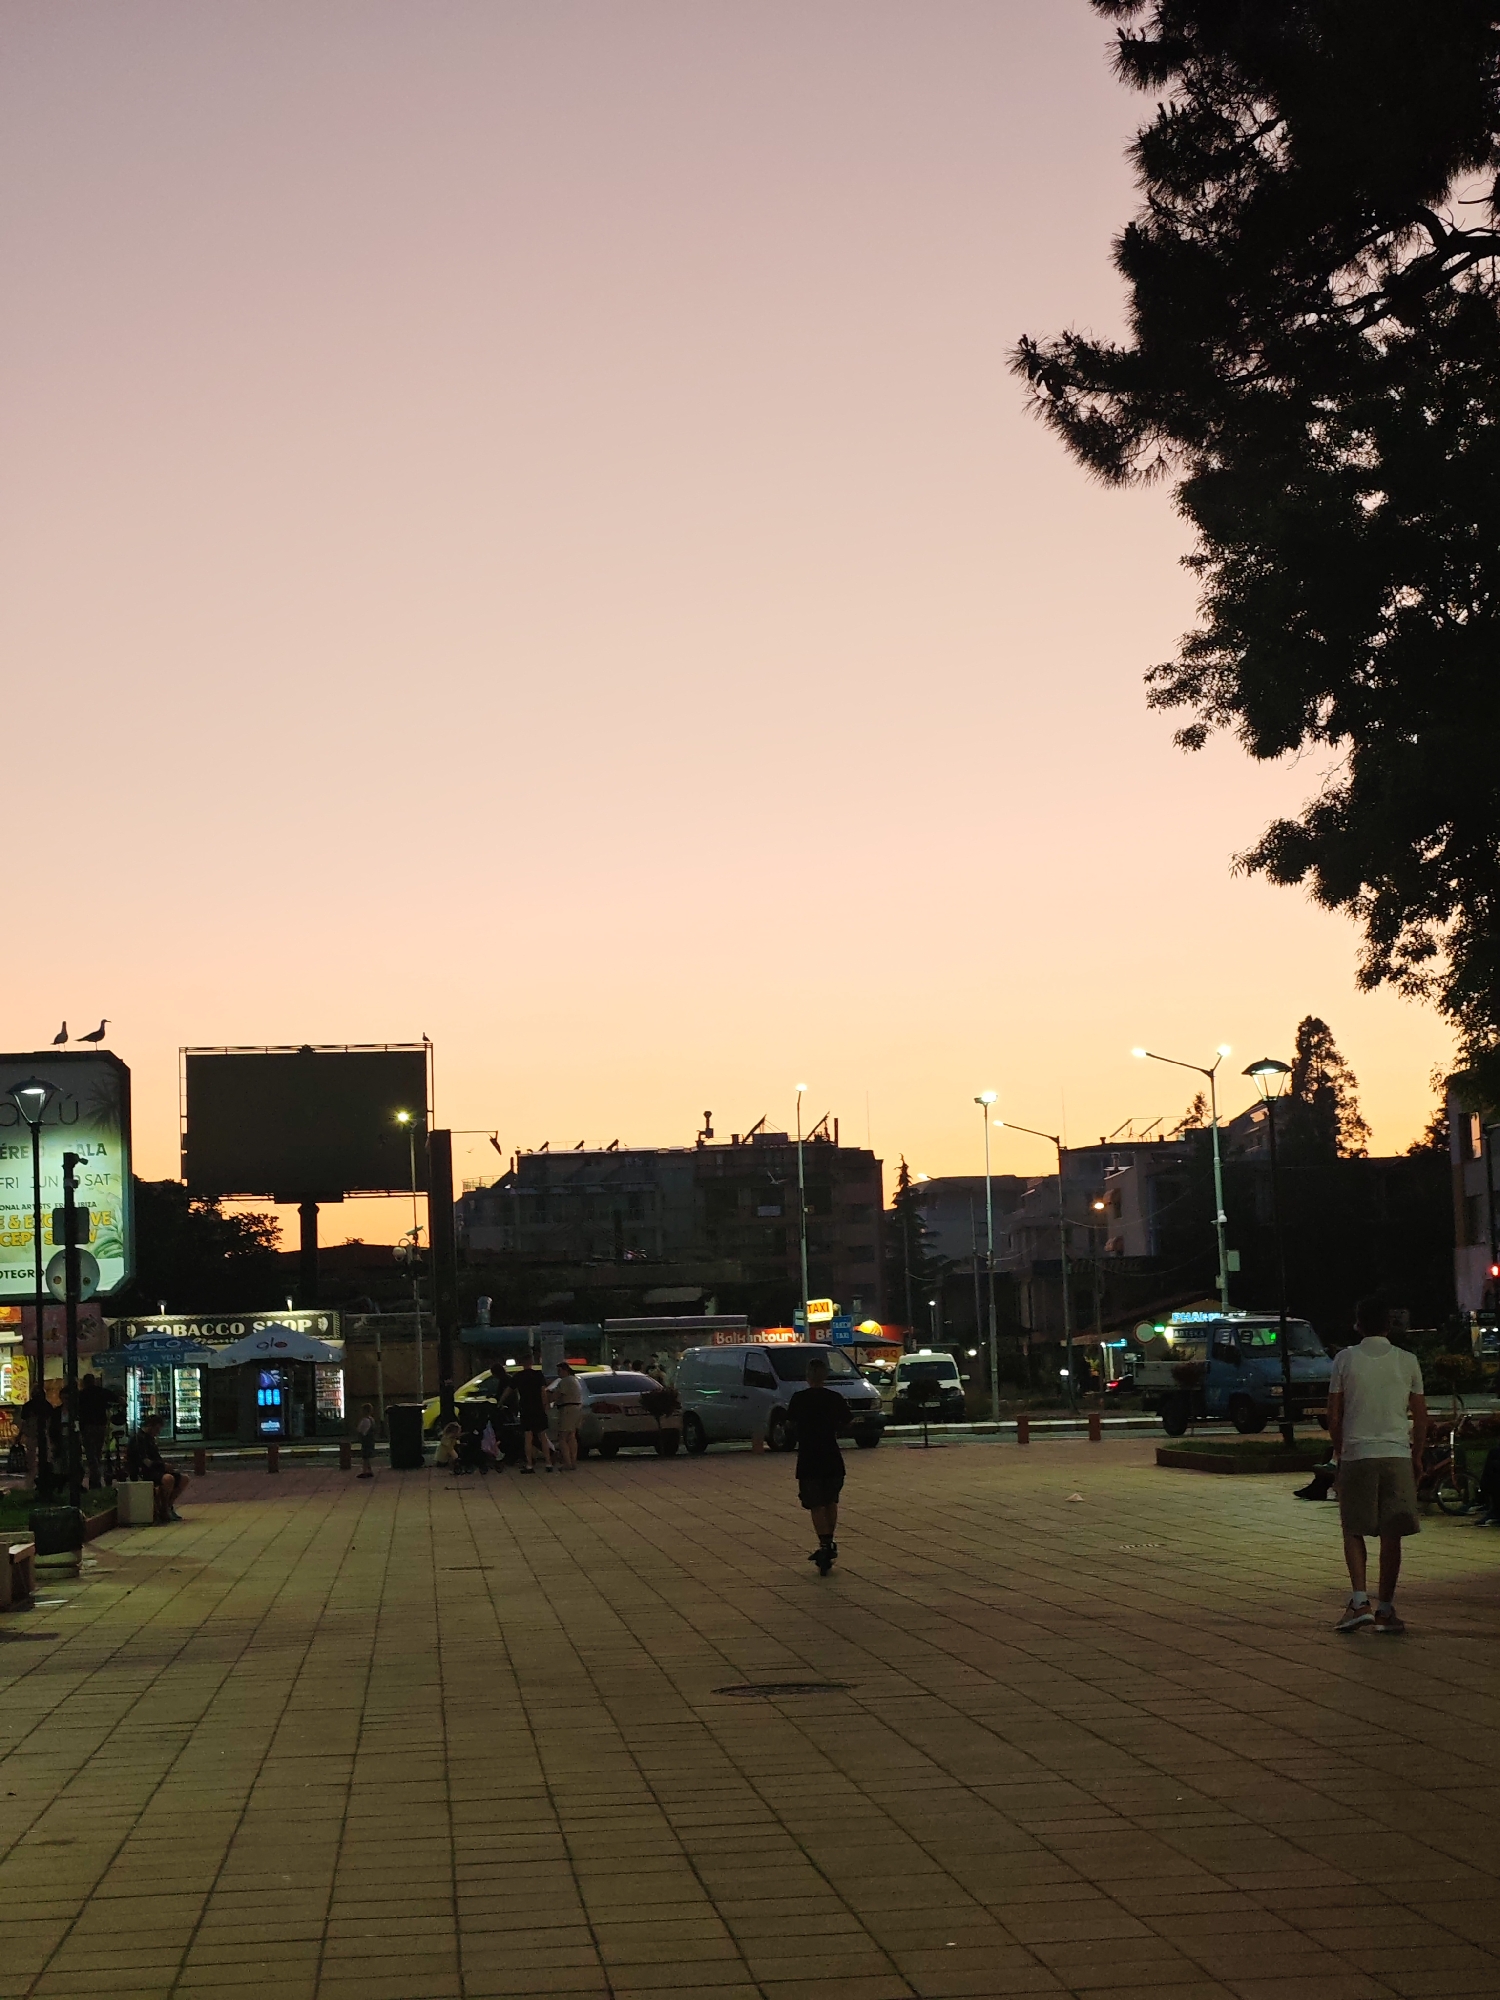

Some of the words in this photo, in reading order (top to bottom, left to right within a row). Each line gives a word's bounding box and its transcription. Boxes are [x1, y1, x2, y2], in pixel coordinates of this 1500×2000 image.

[85, 1174, 110, 1186] SAT
[807, 1302, 829, 1314] TAXI
[144, 1322, 245, 1337] TOBACCO
[123, 1340, 181, 1352] VELO
